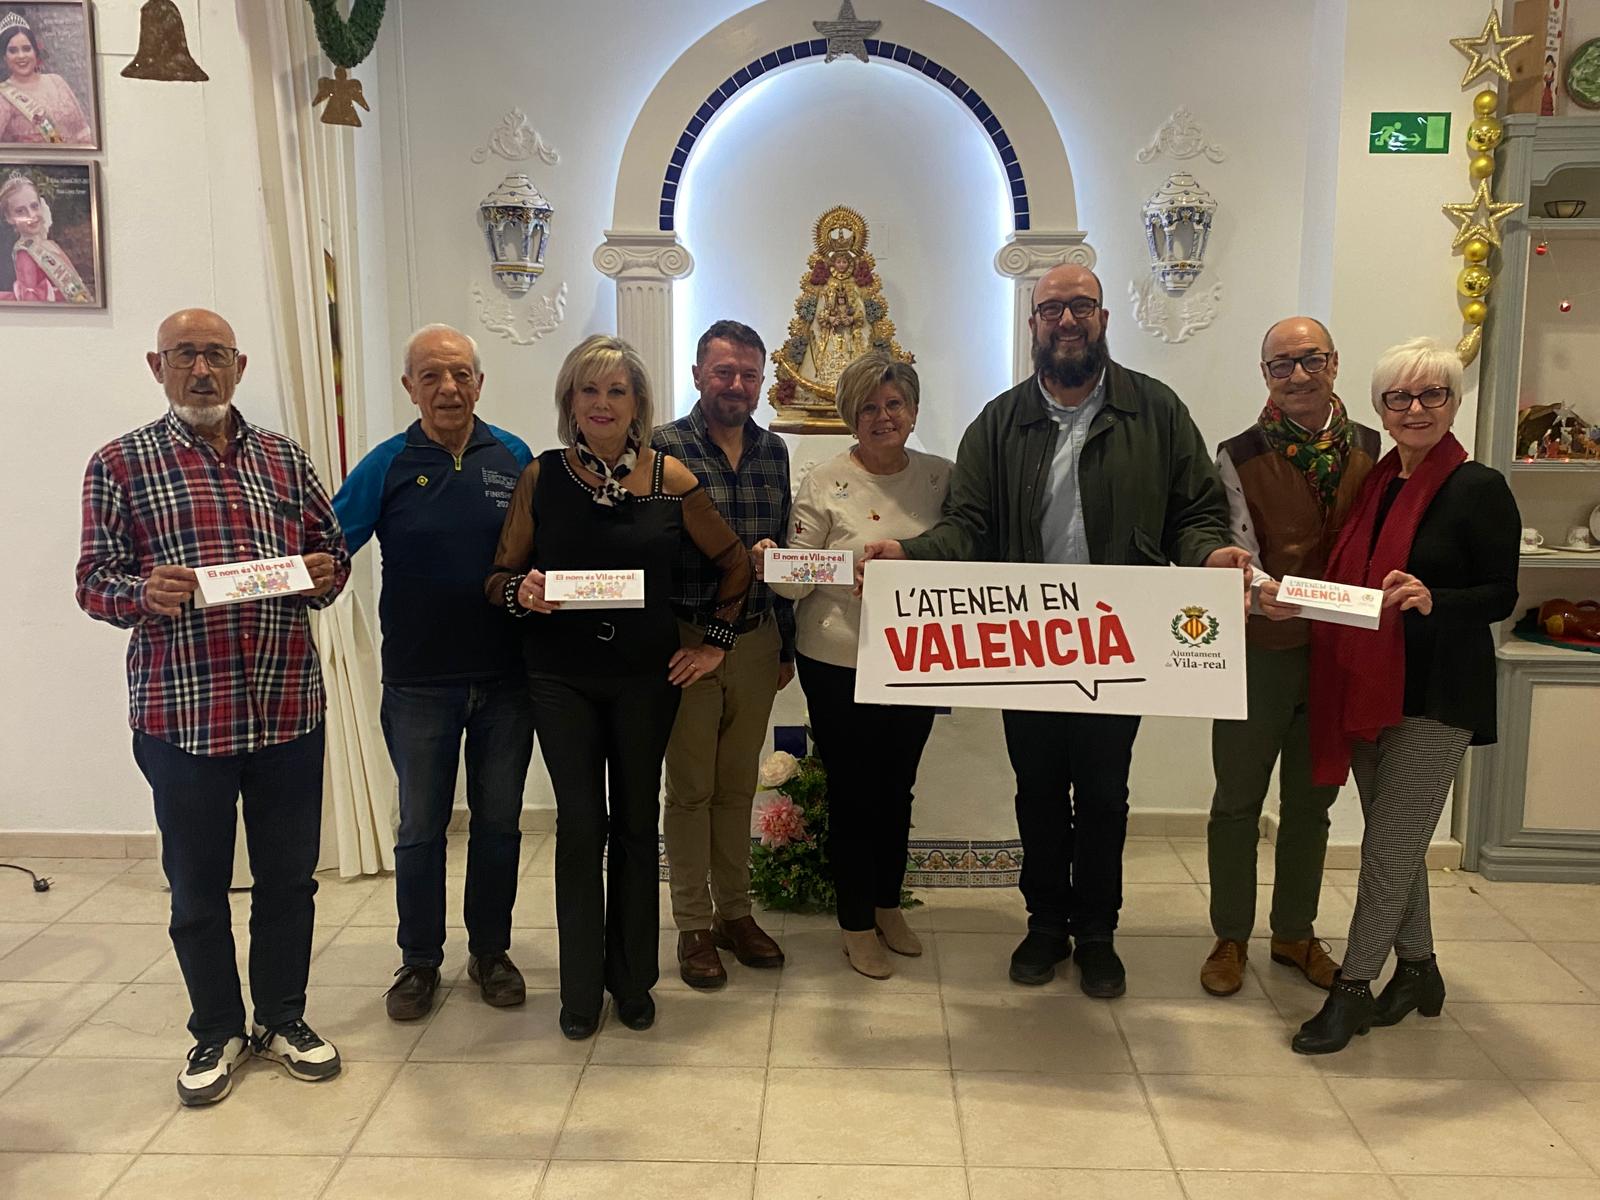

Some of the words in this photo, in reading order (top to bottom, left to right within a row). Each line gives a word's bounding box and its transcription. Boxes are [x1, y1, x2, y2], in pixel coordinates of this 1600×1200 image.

[773, 552, 781, 560] El
[809, 553, 845, 562] Vila-real
[207, 570, 217, 578] El
[219, 569, 240, 577] nom
[251, 560, 295, 573] Vila-real
[595, 573, 635, 581] Vila-real
[895, 583, 1028, 618] L'ATENEM
[1041, 581, 1080, 612] EN
[1286, 586, 1352, 603] VALENCIÀ
[884, 600, 1136, 673] VALENCIÀ
[1170, 649, 1221, 659] Ajuntament
[1172, 657, 1226, 670] Vila-real
